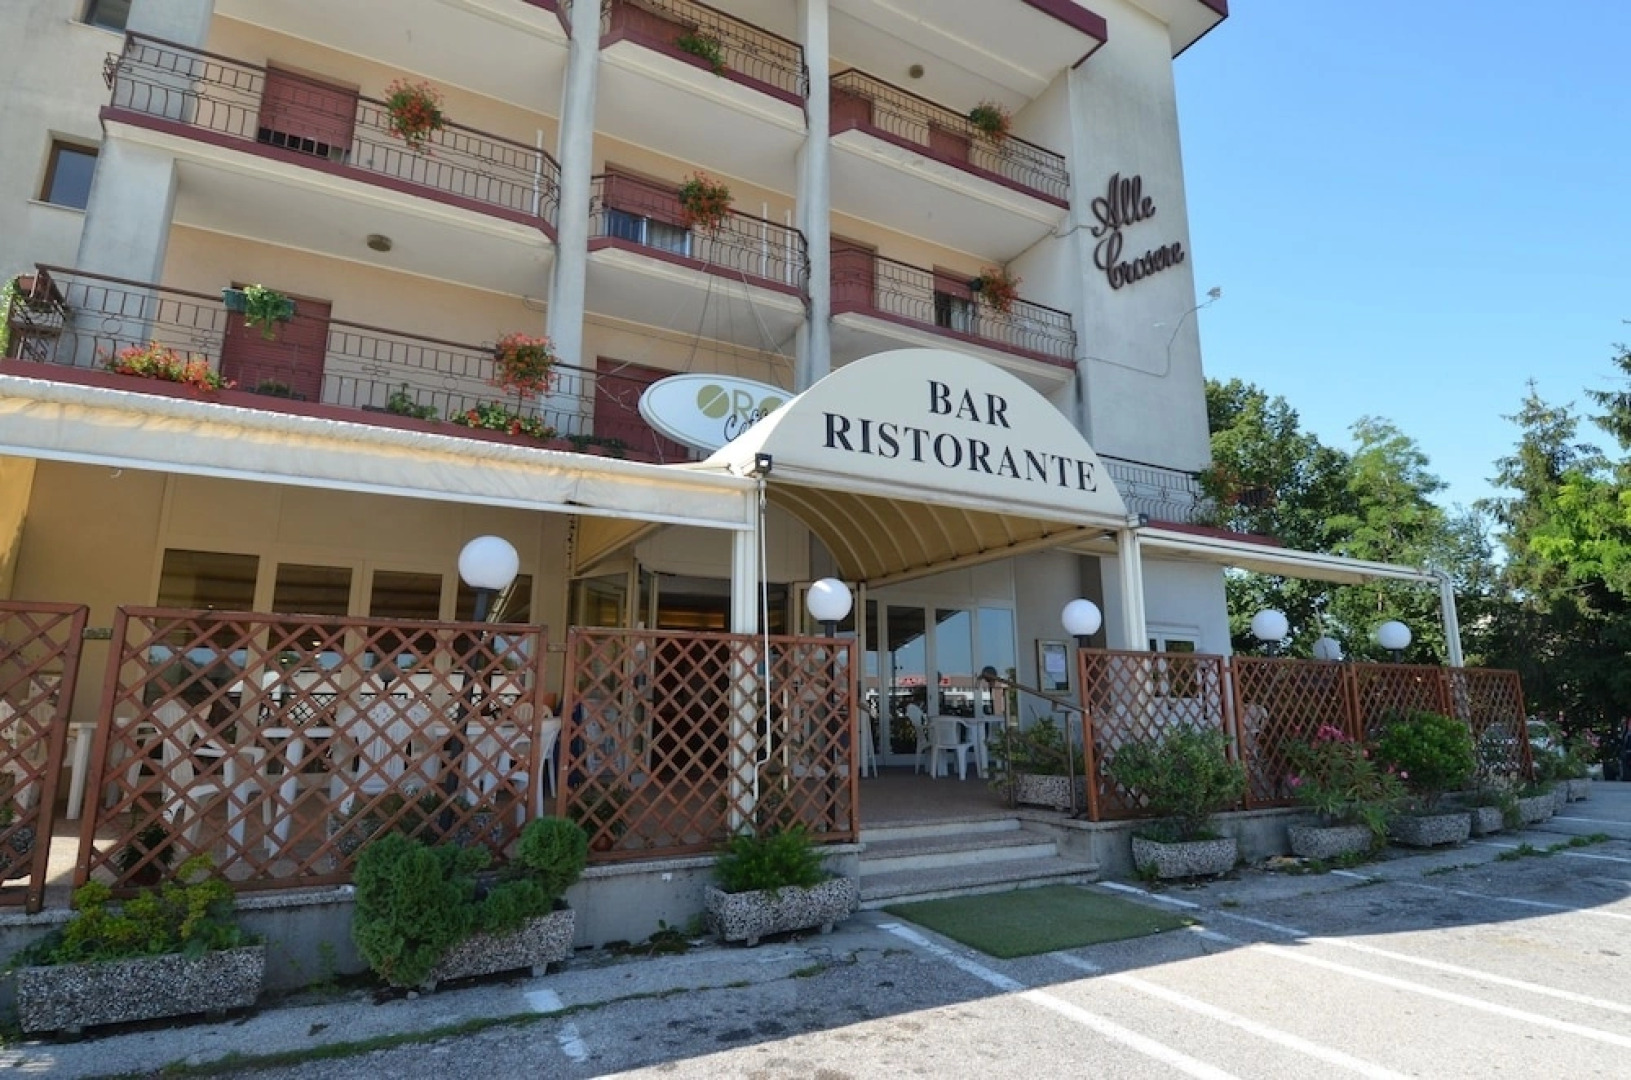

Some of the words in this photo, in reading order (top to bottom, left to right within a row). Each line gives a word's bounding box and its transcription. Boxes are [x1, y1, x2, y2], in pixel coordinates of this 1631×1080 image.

[1091, 172, 1156, 237] Alle
[929, 380, 1009, 428] BAR
[823, 413, 1098, 492] RISTORANTE
